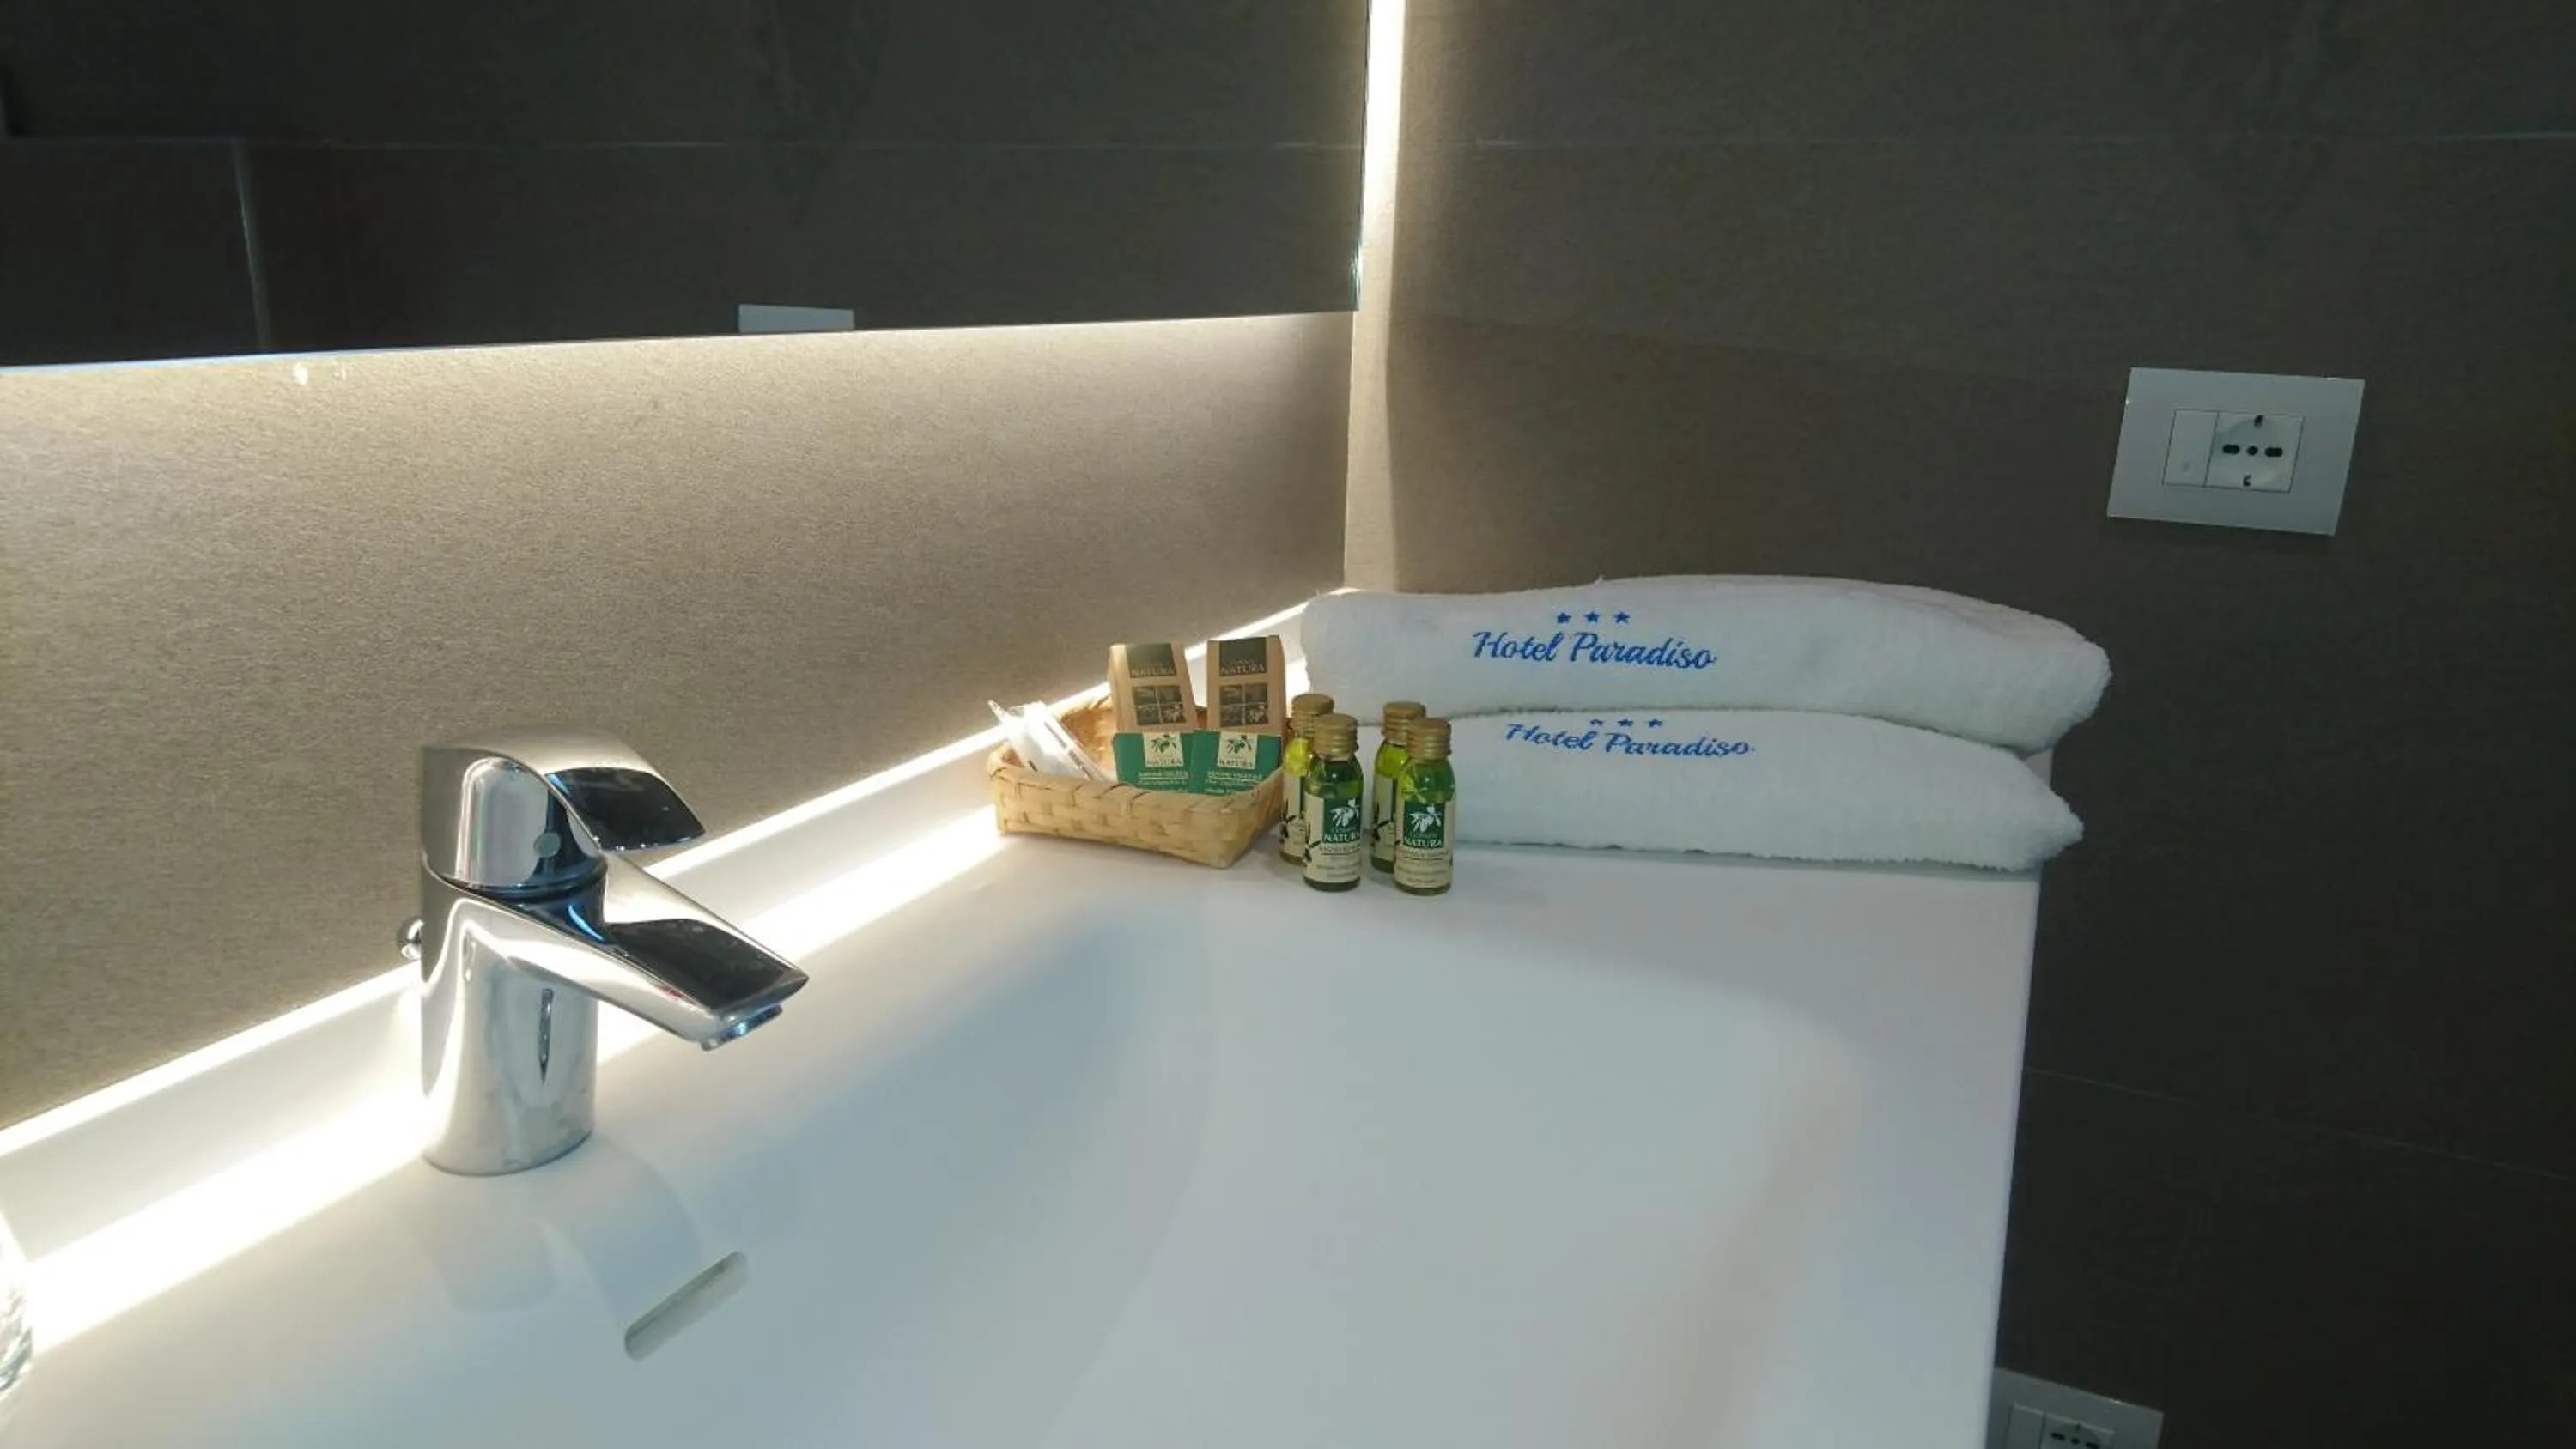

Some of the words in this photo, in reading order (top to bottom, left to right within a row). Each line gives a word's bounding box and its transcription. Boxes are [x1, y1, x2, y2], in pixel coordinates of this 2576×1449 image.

[1473, 631, 1564, 662] Hotel
[1570, 631, 1717, 670] Paradiso
[1130, 666, 1176, 678] NATURA
[1220, 664, 1266, 677] NATURA
[1506, 723, 1599, 751] Hotel
[1604, 732, 1750, 757] Paradiso
[1404, 836, 1443, 847] NATURA
